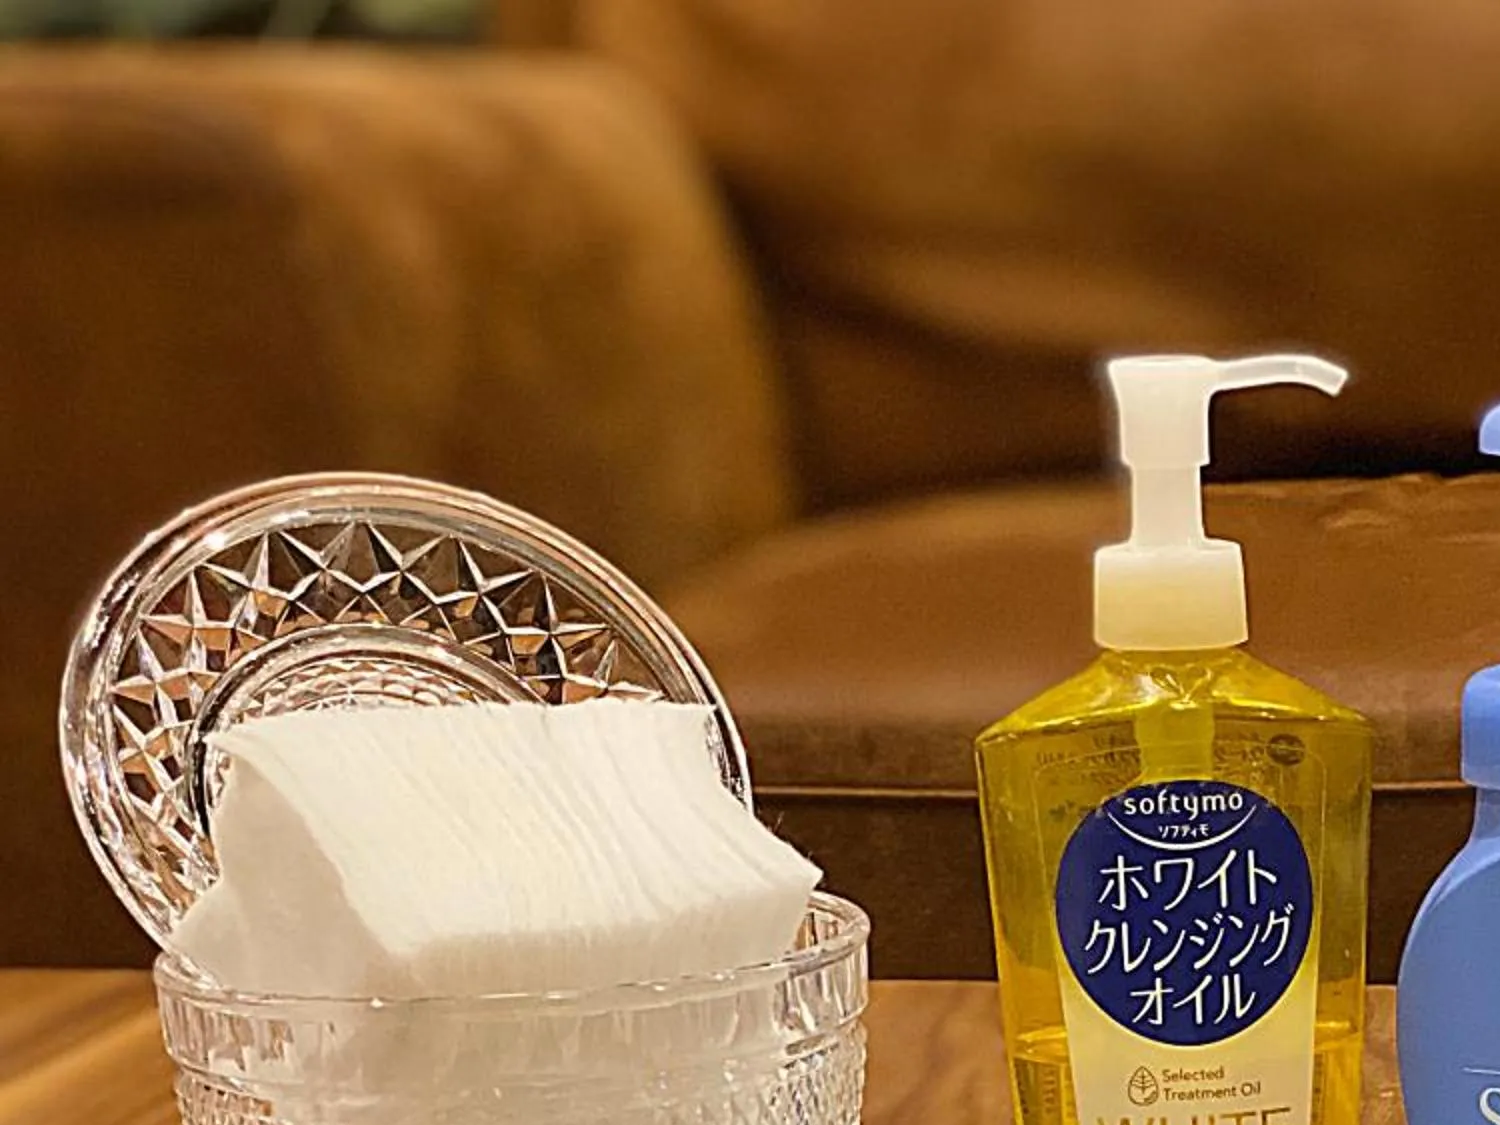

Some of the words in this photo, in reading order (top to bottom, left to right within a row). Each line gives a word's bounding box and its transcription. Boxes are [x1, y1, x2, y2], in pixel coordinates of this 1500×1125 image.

[1123, 788, 1244, 821] softymo
[1157, 823, 1210, 838] ソフティモ
[1098, 849, 1278, 911] ホワイト
[1084, 902, 1296, 975] クレンジング
[1129, 972, 1257, 1026] オイル
[1161, 1066, 1225, 1083] Selected
[1162, 1086, 1237, 1102] Treatment
[1240, 1081, 1261, 1097] Oil
